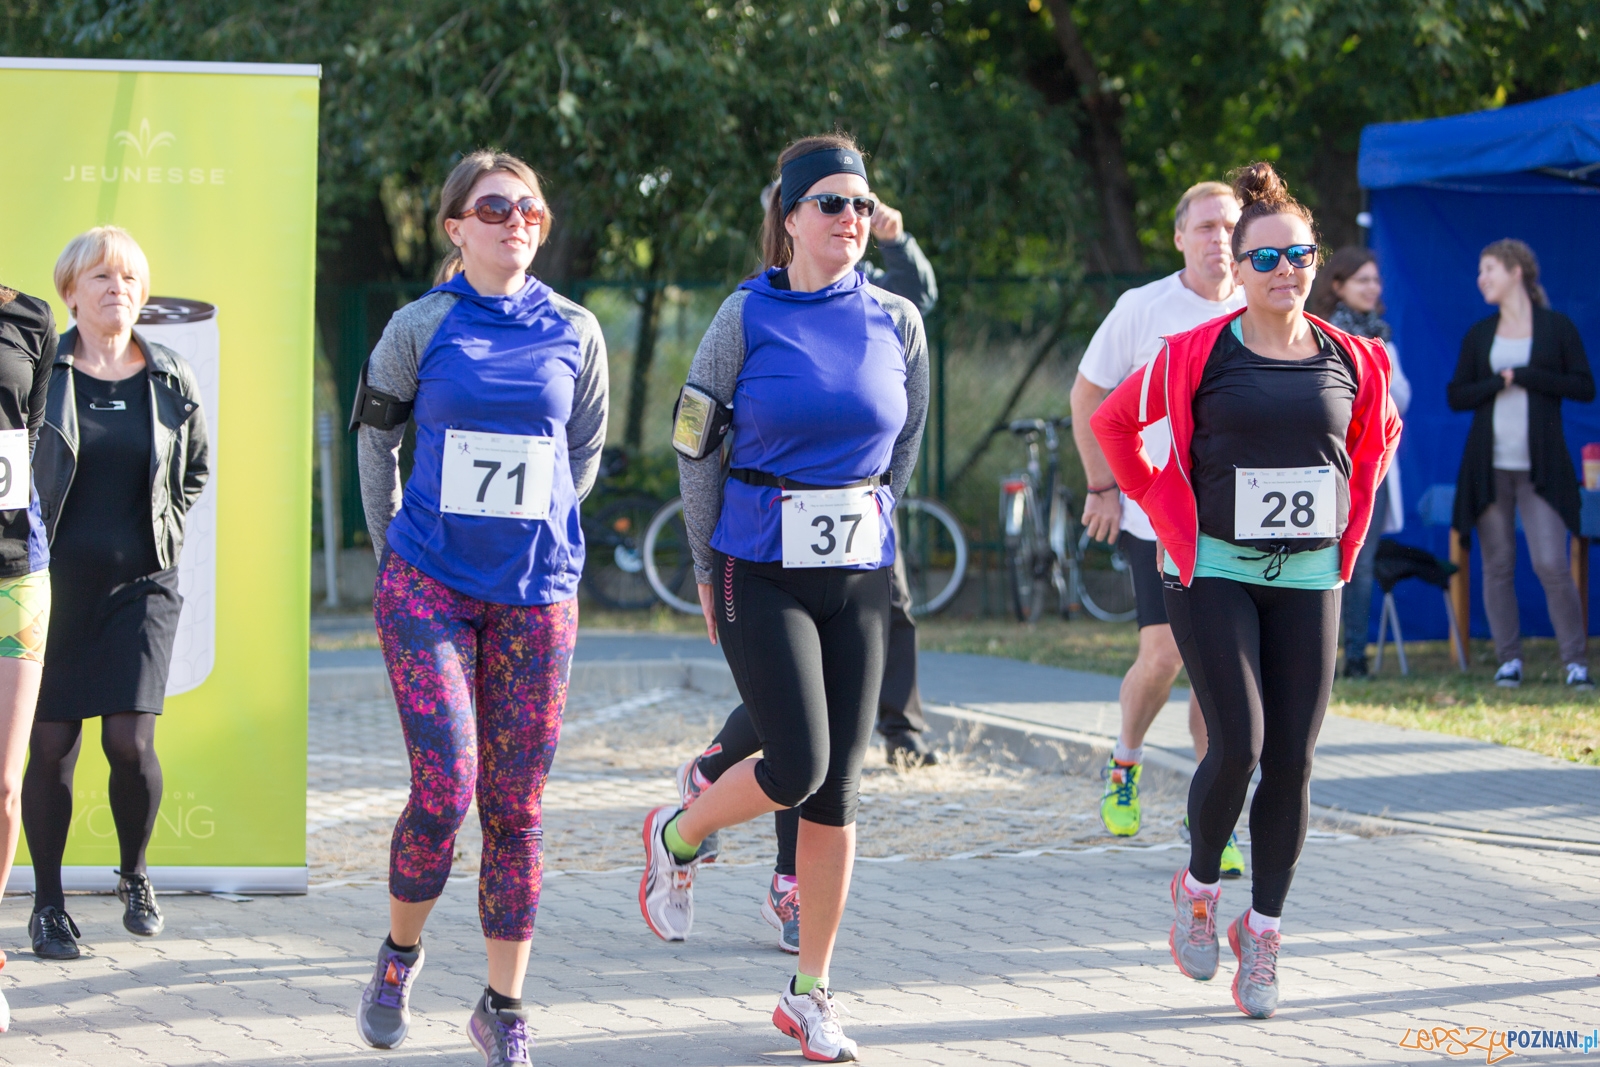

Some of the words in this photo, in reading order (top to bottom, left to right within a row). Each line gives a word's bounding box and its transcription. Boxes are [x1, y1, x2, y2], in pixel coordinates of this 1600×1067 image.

[63, 165, 225, 185] JEUNESSE
[473, 459, 526, 505] 71
[1260, 490, 1315, 528] 28
[810, 514, 863, 556] 37
[71, 804, 215, 839] YONG
